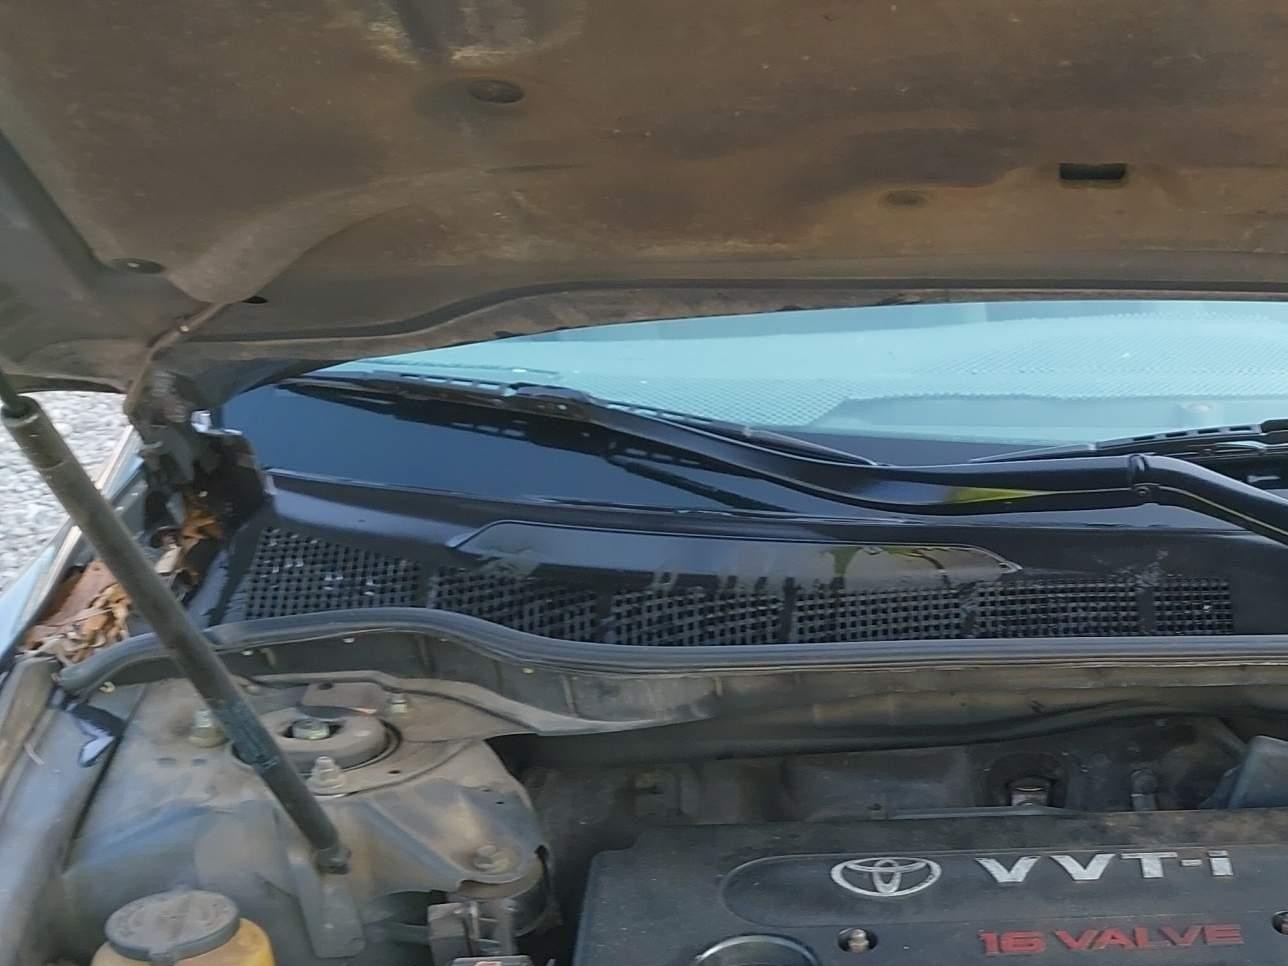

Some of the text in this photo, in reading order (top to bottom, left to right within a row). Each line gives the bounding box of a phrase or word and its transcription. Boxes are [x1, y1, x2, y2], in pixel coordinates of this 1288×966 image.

[975, 850, 1234, 883] VVT-i
[978, 923, 1245, 956] 16 VALVE
